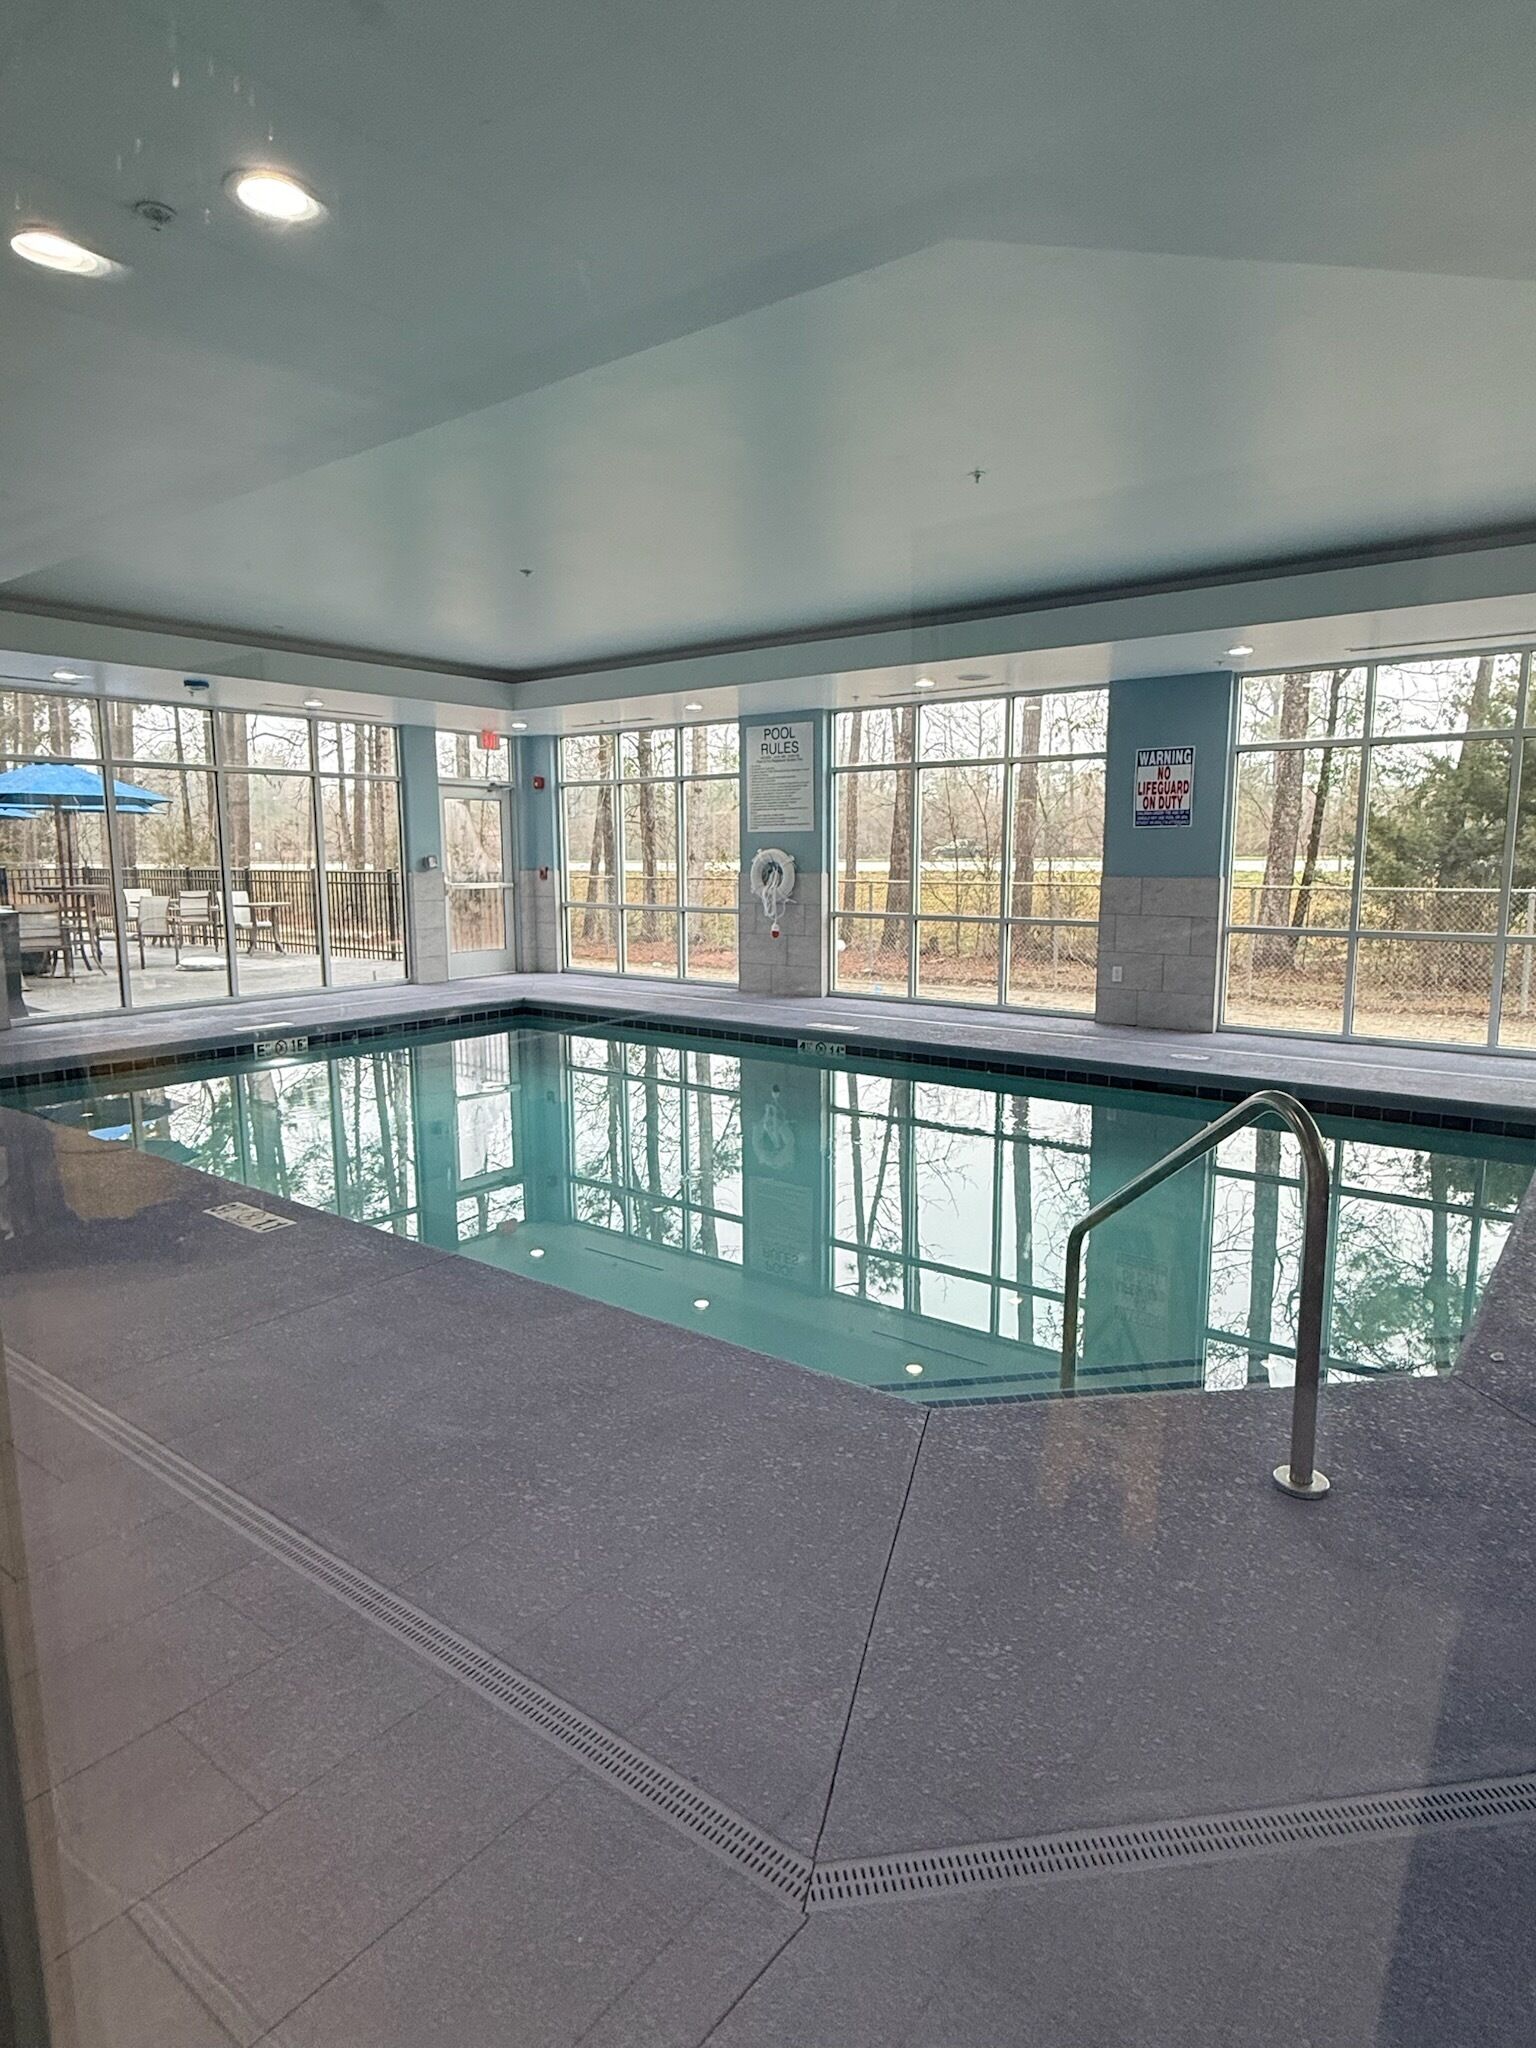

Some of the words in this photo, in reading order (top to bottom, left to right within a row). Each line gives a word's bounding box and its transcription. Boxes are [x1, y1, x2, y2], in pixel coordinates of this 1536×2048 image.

[763, 726, 795, 741] POOL
[760, 740, 799, 755] RULES
[1139, 748, 1192, 766] WARNING
[1157, 766, 1171, 780] NO
[1137, 780, 1190, 796] LIFEGUARD
[1142, 796, 1156, 810] ON
[1158, 795, 1183, 809] DUTY
